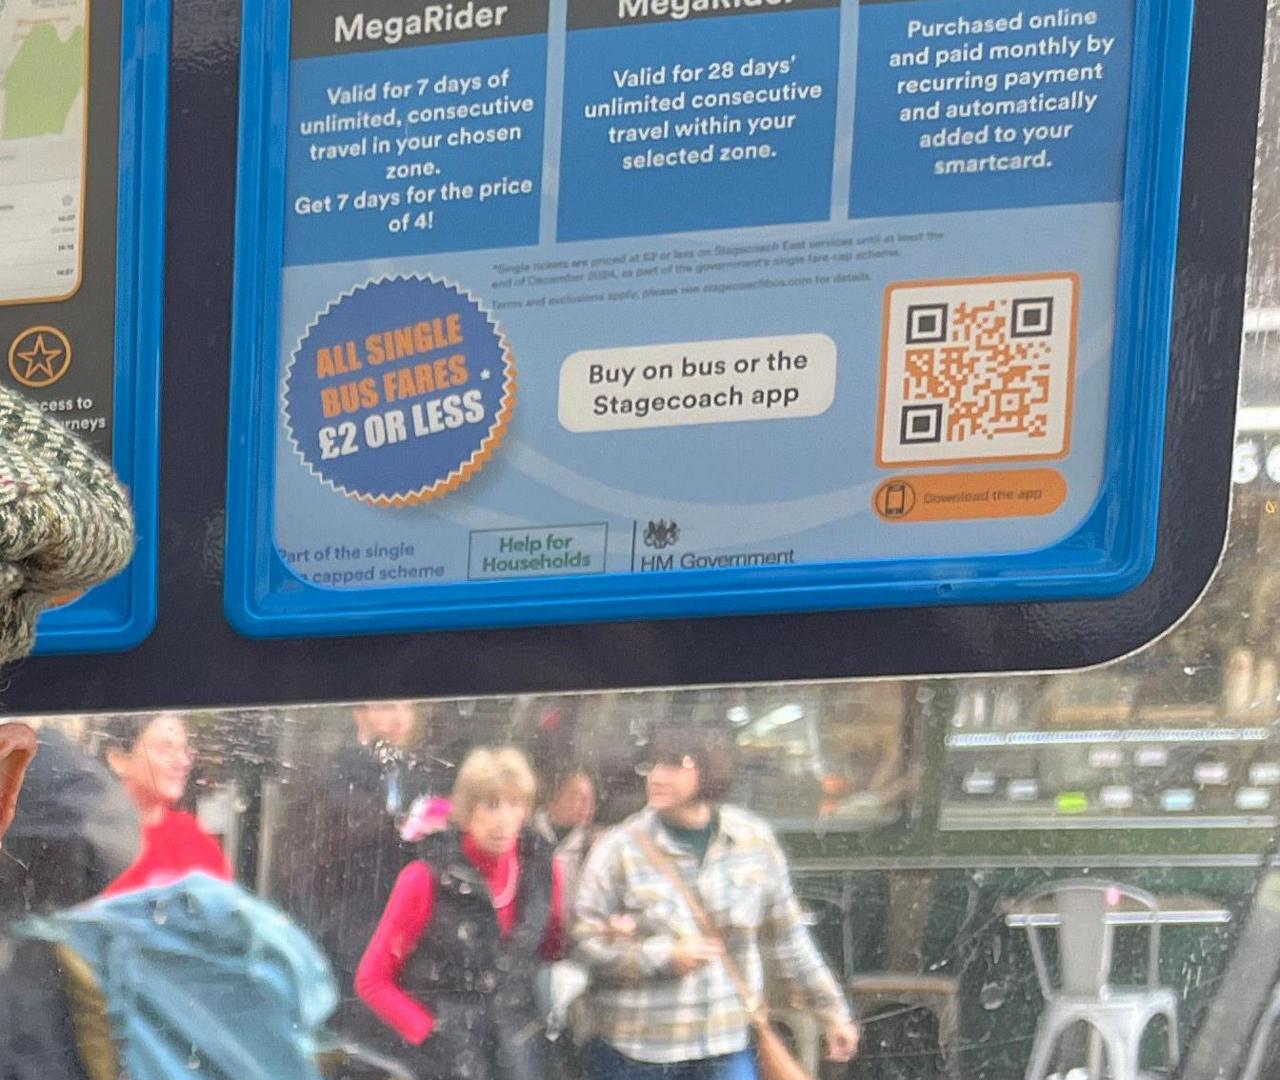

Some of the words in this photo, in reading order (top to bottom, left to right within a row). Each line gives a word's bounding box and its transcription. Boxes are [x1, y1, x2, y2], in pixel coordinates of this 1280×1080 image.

[334, 1, 508, 44] MegaRider
[908, 13, 1022, 38] Purchased
[1029, 8, 1098, 30] online
[889, 47, 929, 67] and
[935, 43, 983, 68] paid
[989, 36, 1081, 60] monthly
[1087, 34, 1115, 55] by
[327, 84, 376, 105] Valid
[383, 80, 412, 100] for
[417, 79, 429, 97] 7
[433, 75, 481, 95] days
[488, 68, 510, 88] of
[613, 66, 666, 88] Valid
[672, 64, 703, 84] for
[708, 61, 734, 80] 28
[897, 71, 997, 94] recurring
[1004, 63, 1104, 91] payment
[300, 109, 401, 135] unlimited,
[408, 95, 533, 123] consecutive
[584, 92, 685, 118] unlimited
[691, 82, 822, 109] consecutive
[899, 102, 939, 122] and
[945, 91, 1098, 119] automatically
[310, 139, 366, 160] travel
[372, 136, 390, 153] in
[396, 135, 442, 156] your
[447, 125, 521, 146] chosen
[608, 120, 669, 144] travel
[675, 115, 741, 137] within
[748, 113, 796, 135] your
[919, 125, 988, 148] added
[994, 126, 1016, 143] to
[1023, 123, 1073, 145] your
[386, 161, 441, 180] zone.
[623, 144, 714, 170] selected
[720, 143, 776, 162] zone.
[934, 150, 1053, 175] smartcard.
[294, 196, 332, 215] Get
[337, 193, 349, 211] 7
[353, 191, 401, 211] days
[406, 186, 436, 204] for
[440, 181, 473, 201] the
[479, 177, 532, 201] price
[388, 213, 411, 233] of
[414, 211, 433, 231] 4!
[316, 341, 362, 379] ALL
[365, 313, 463, 365] SINGLE
[588, 364, 635, 387] Buy
[642, 364, 672, 380] on
[681, 357, 726, 378] bus
[734, 358, 760, 373] or
[766, 351, 808, 372] the
[320, 377, 379, 418] BUS
[383, 353, 469, 402] FARES
[40, 400, 74, 413] cess
[76, 397, 93, 410] to
[593, 386, 743, 418] Stagecoach
[751, 387, 799, 407] app
[59, 416, 106, 432] rneys
[318, 421, 359, 460] £2
[364, 410, 406, 449] OR
[314, 546, 330, 561] of
[334, 545, 360, 561] the
[366, 541, 415, 561] single
[499, 535, 541, 555] Help
[545, 535, 573, 549] for
[640, 555, 674, 572] HM
[680, 549, 795, 570] Government
[312, 566, 375, 585] capped
[379, 564, 445, 580] scheme
[482, 552, 591, 572] Households
